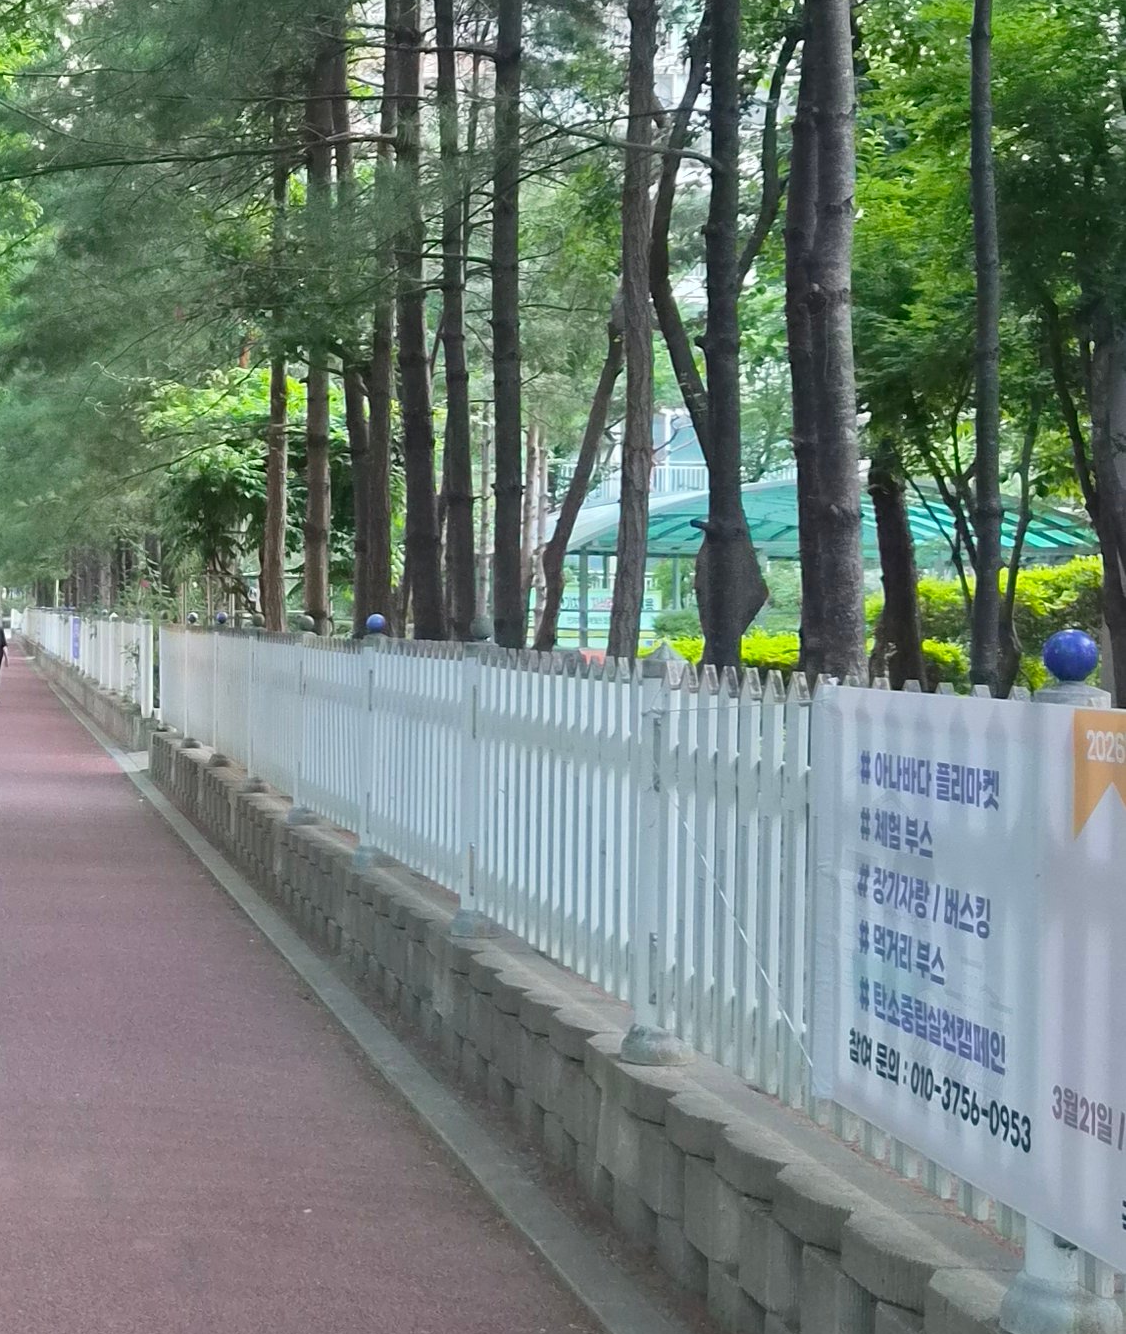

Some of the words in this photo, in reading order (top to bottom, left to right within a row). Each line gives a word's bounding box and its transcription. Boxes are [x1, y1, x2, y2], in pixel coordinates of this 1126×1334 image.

[1086, 729, 1125, 764] 2026
[875, 752, 932, 797] 아나바다
[936, 762, 1000, 811] 플리마켓
[874, 808, 901, 850] 체험
[905, 816, 933, 859] 부스
[873, 867, 930, 919] 장기자랑
[944, 887, 991, 939] 버스킹
[874, 924, 913, 973] 먹거리
[915, 940, 945, 986] 부스
[874, 981, 1006, 1076] 탄소중립실천캠페인
[849, 1027, 873, 1071] 참여
[875, 1042, 900, 1085] 문의
[910, 1061, 1031, 1154] 010-3756-0953
[1052, 1085, 1113, 1145] 3월21일
